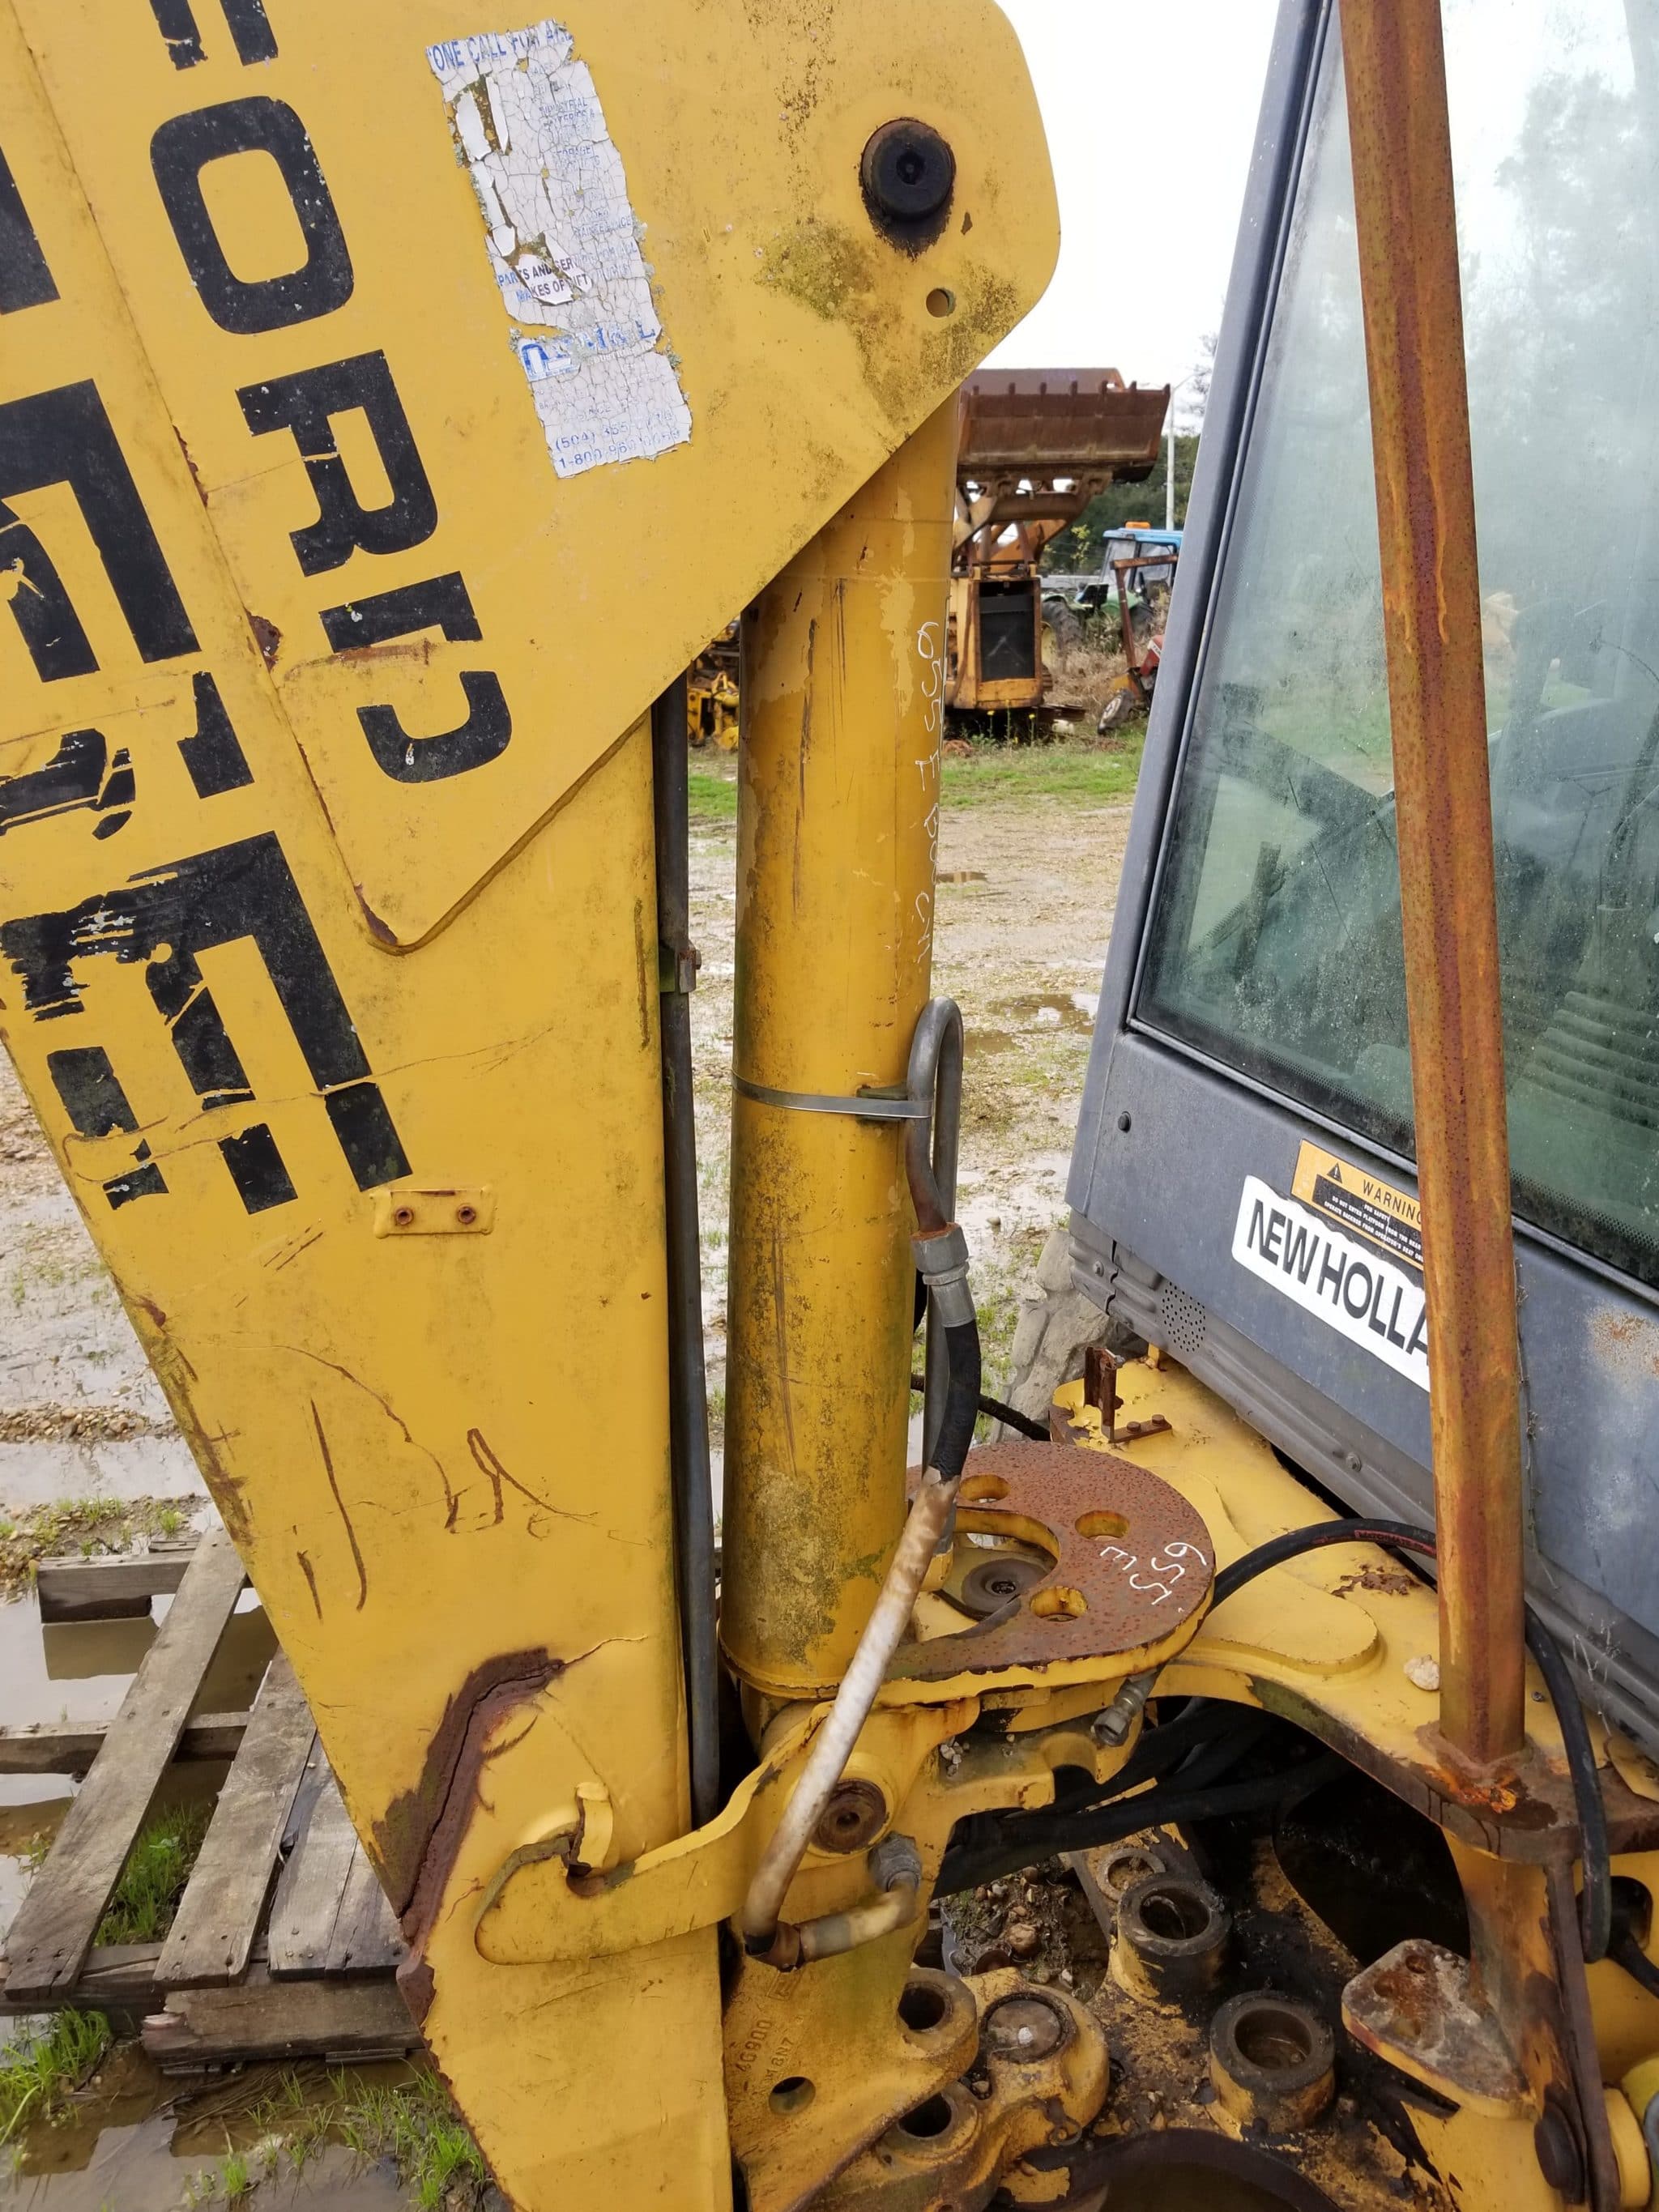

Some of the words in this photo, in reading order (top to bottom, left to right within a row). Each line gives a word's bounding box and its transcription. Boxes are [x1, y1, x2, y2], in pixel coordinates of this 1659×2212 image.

[467, 33, 506, 62] CALL
[531, 262, 552, 278] AND
[552, 279, 565, 293] OF
[1247, 1199, 1320, 1285] NEW
